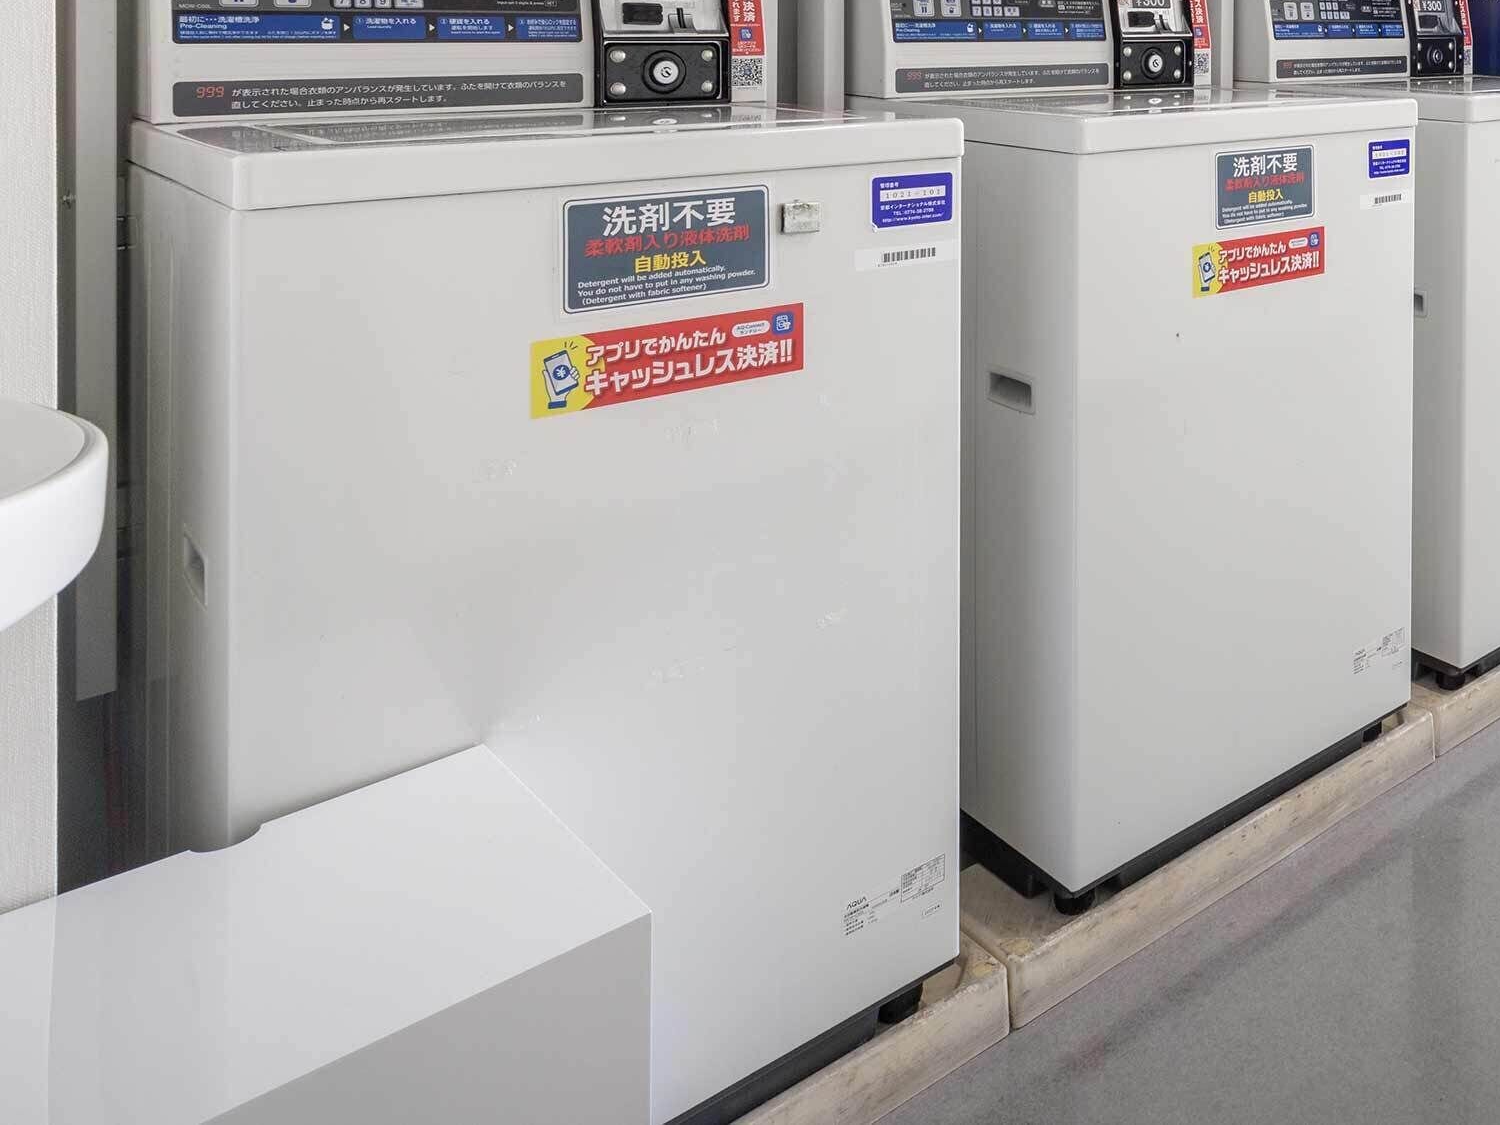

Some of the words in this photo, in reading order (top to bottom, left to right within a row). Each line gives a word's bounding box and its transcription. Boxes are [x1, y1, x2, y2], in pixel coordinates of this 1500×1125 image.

[1421, 0, 1443, 12] ¥300
[365, 17, 417, 25] 洗濯物を入れる
[1233, 152, 1298, 178] 洗剤不要
[1248, 188, 1284, 204] 自動投入
[602, 197, 737, 238] 洗剤不要
[584, 223, 751, 258] 柔軟剤入り液体洗剤
[1218, 241, 1287, 264] アプリでかんたん
[634, 249, 707, 274] 自動投入
[1218, 251, 1320, 285] キャッシュレス決済!!
[577, 278, 621, 289] Detergent
[622, 275, 635, 284] will
[637, 274, 647, 282] be
[648, 271, 673, 281] added
[674, 265, 726, 277] automatically.
[578, 289, 594, 298] You
[595, 287, 607, 296] do
[608, 285, 622, 293] not
[624, 282, 644, 292] have
[645, 280, 654, 289] to
[655, 279, 669, 289] put
[670, 277, 678, 286] in
[679, 278, 694, 287] any
[695, 272, 727, 284] washing
[727, 269, 757, 281] powder.
[582, 293, 628, 306] (Detergent
[628, 291, 648, 300] with
[648, 287, 671, 298] fabric
[671, 282, 708, 295] softener)
[584, 325, 727, 367] アプリでかんたん
[583, 338, 794, 396] キャッシュレス決済!!
